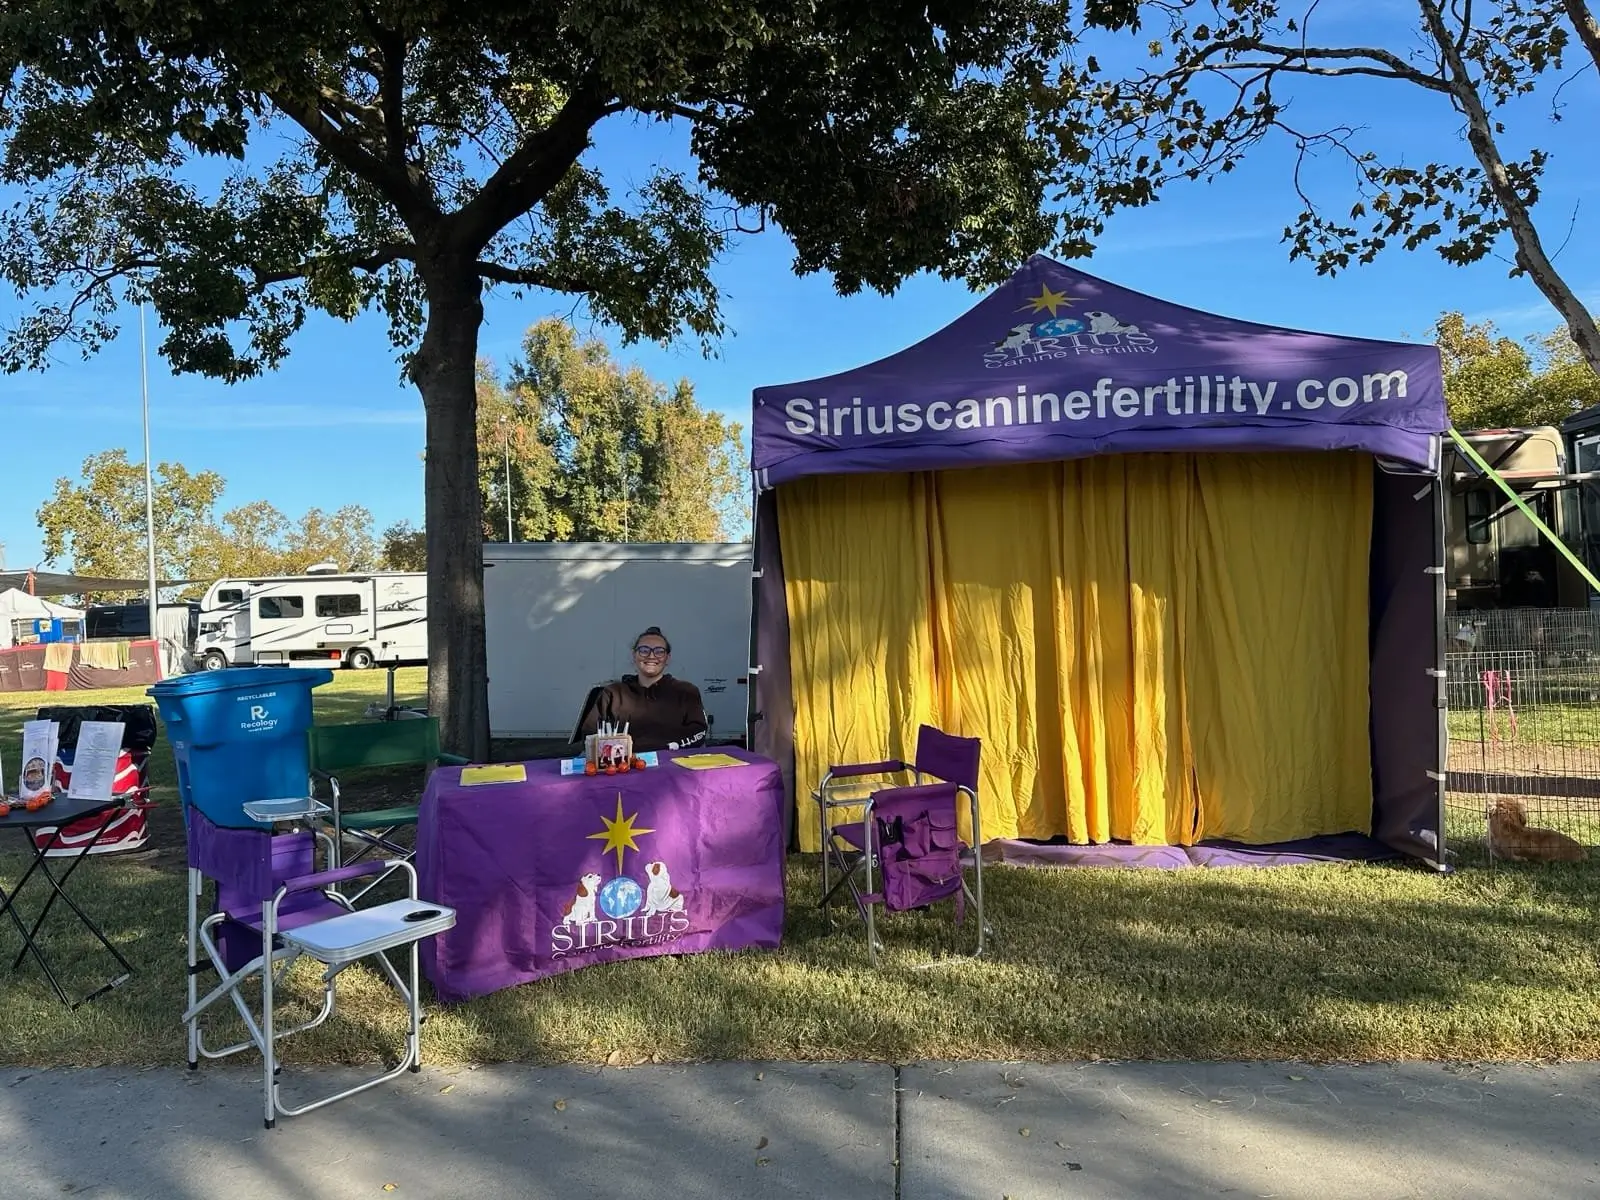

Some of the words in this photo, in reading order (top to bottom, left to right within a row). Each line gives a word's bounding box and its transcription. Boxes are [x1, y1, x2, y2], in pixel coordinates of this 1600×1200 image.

[983, 332, 1155, 364] SIRIUS
[985, 350, 1067, 369] Canine
[1075, 344, 1159, 356] Fertility
[785, 369, 1408, 437] Siriuscaninefertility.com
[241, 719, 278, 729] Recology
[552, 910, 690, 951] SIRIUS
